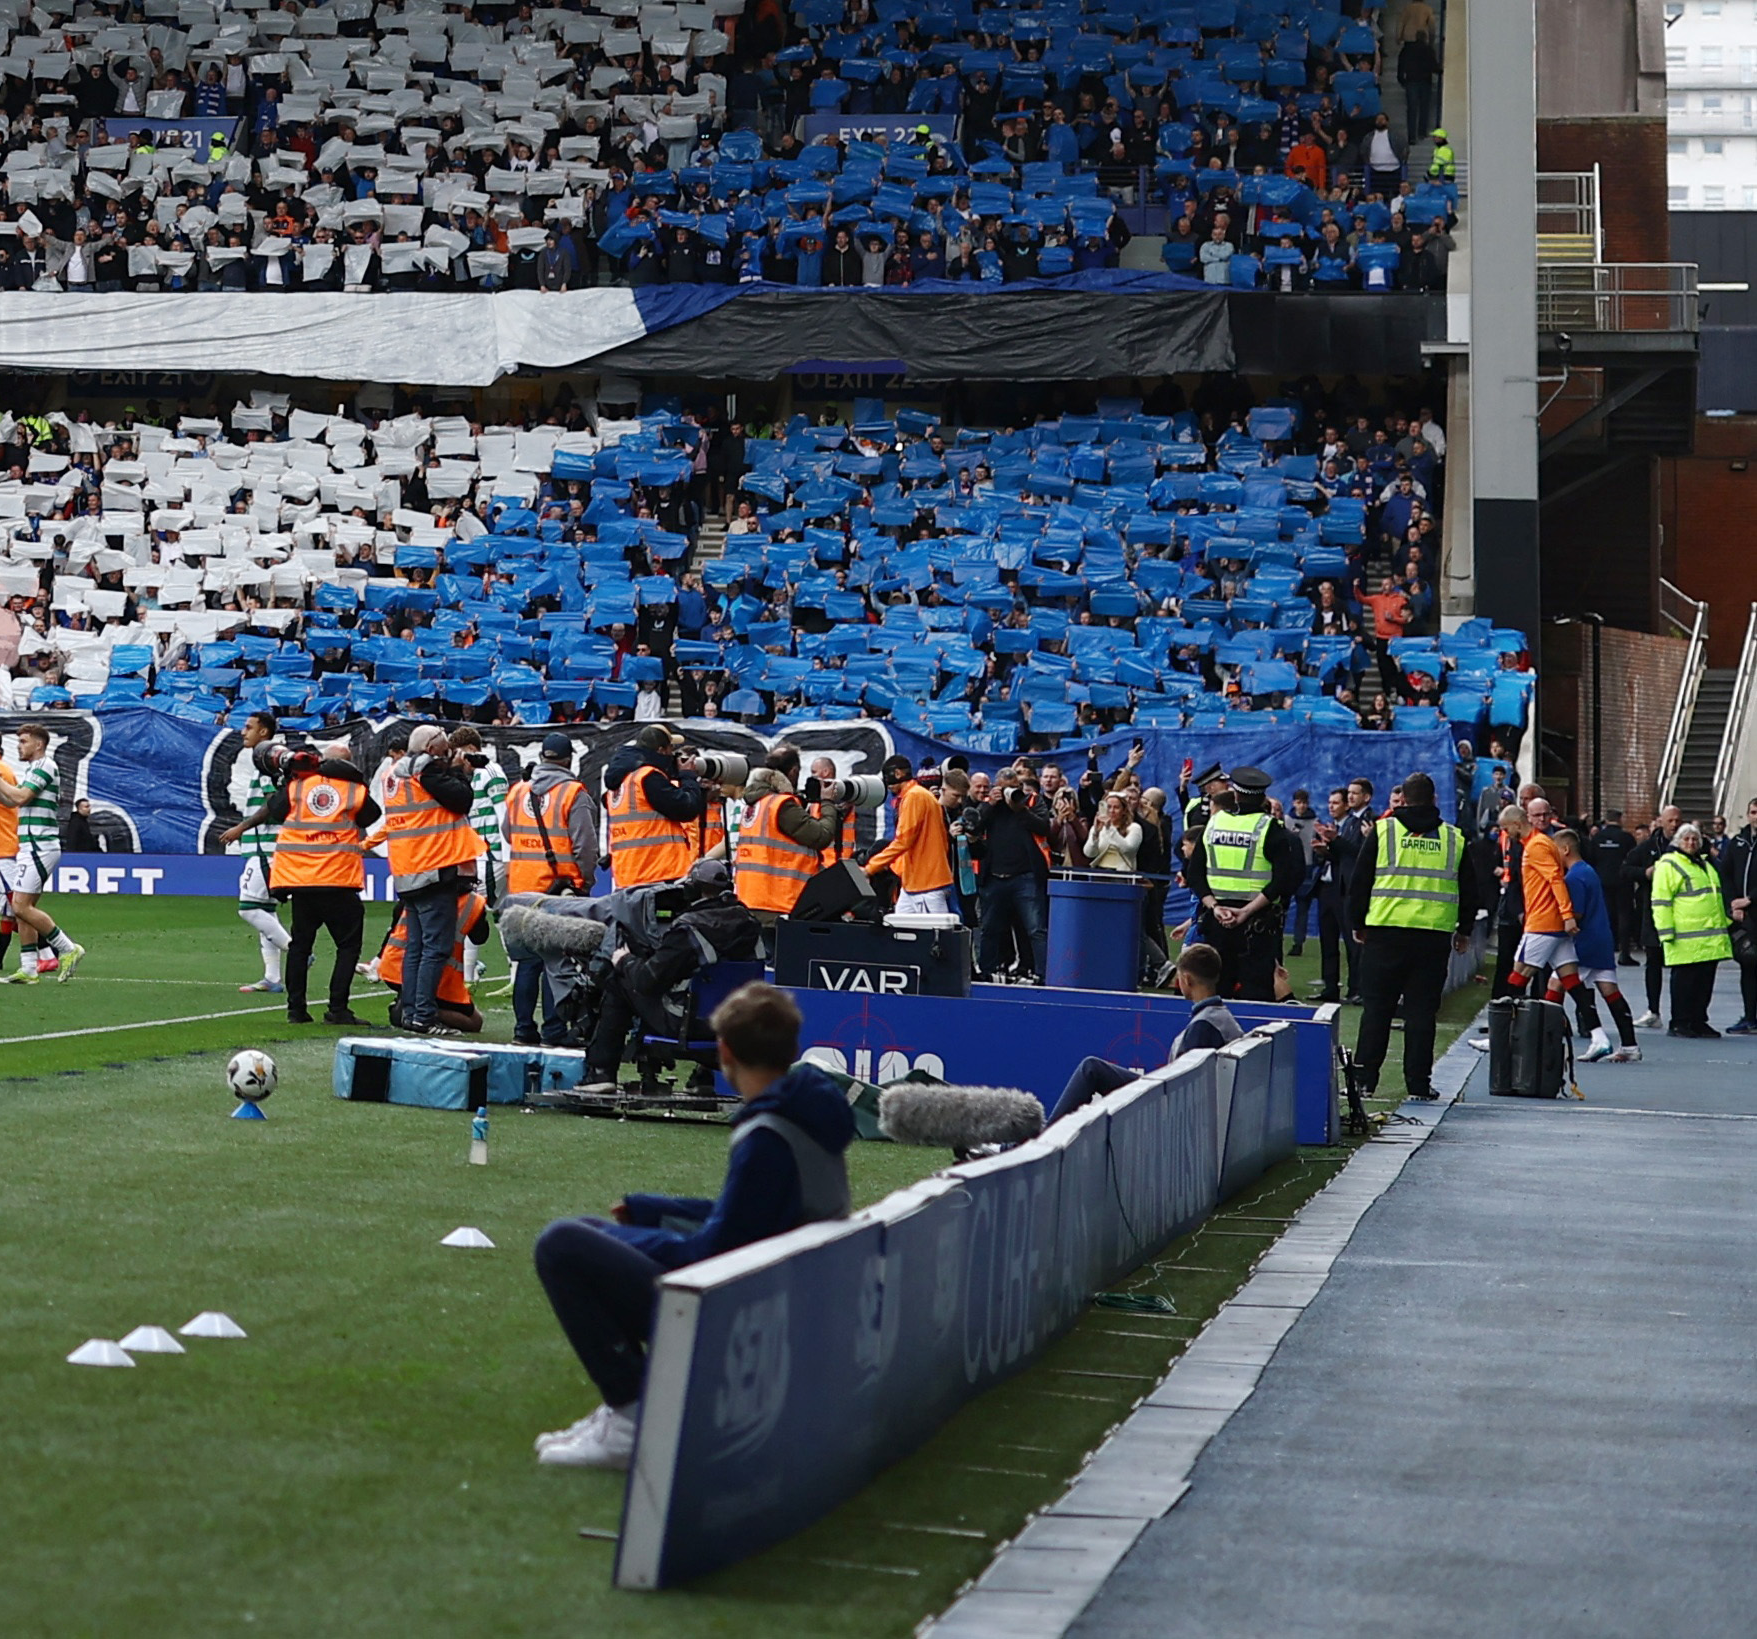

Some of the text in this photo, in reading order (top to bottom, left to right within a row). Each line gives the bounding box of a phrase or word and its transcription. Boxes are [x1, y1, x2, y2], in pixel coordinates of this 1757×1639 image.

[1212, 831, 1251, 846] POLICE
[1400, 838, 1441, 852] GARRION
[818, 966, 910, 995] VAR
